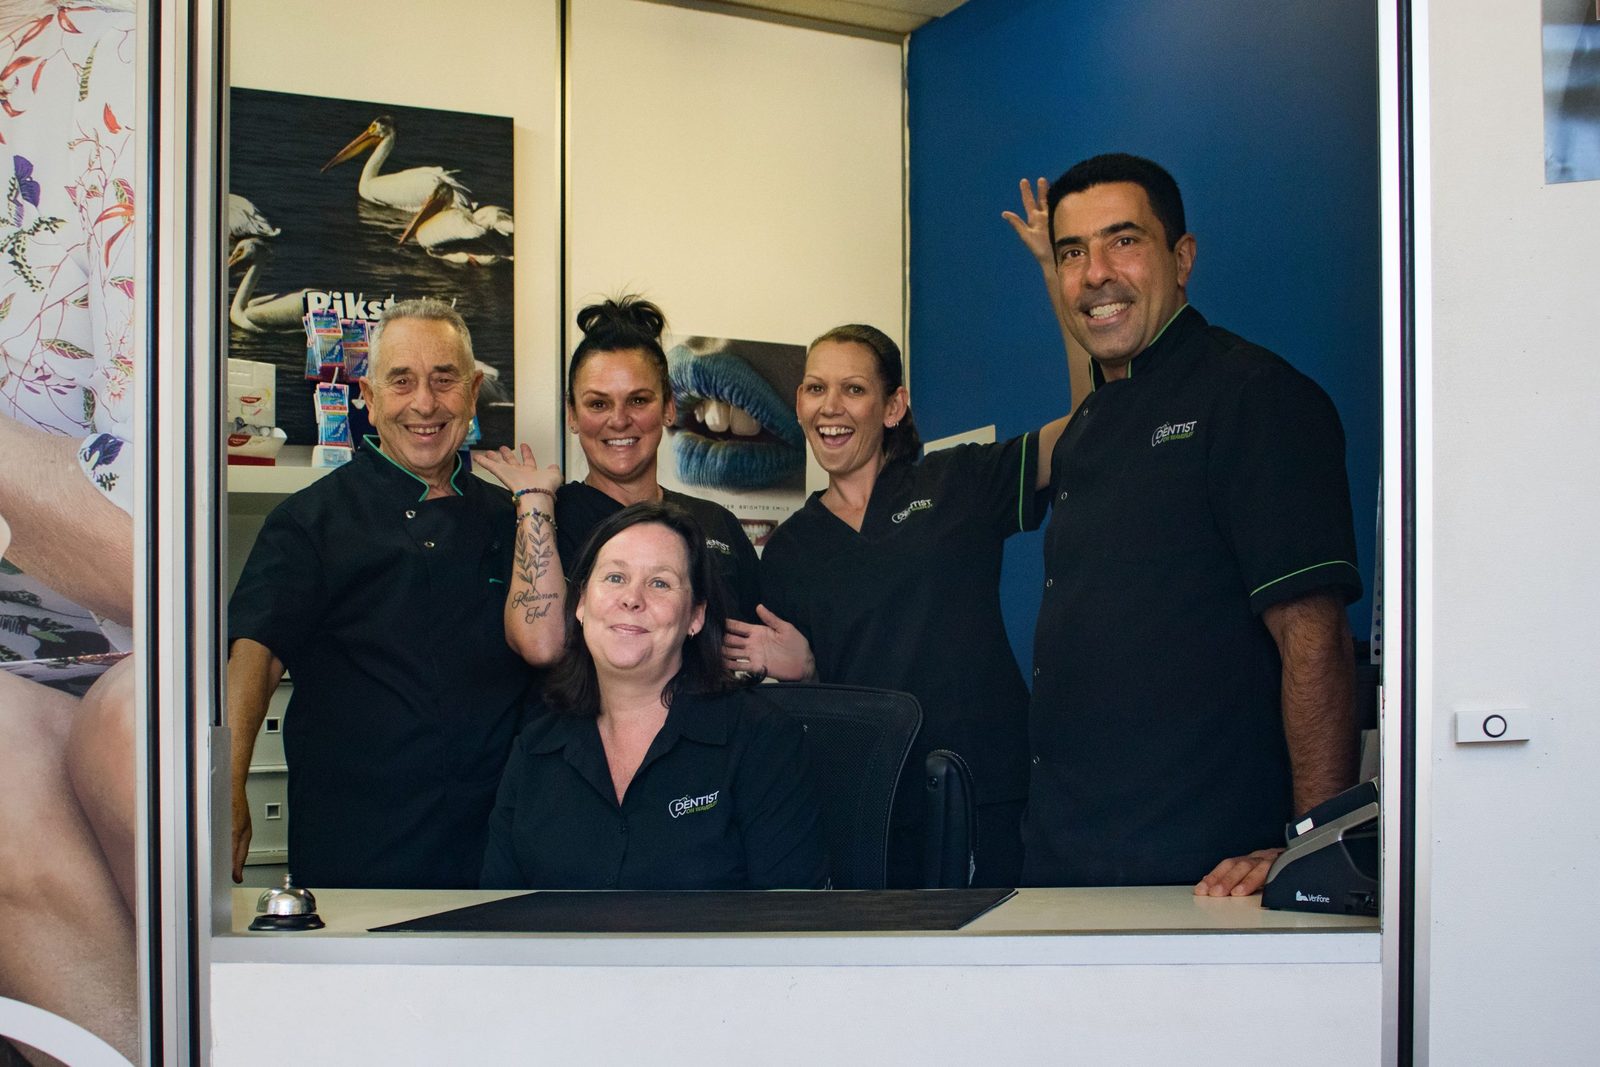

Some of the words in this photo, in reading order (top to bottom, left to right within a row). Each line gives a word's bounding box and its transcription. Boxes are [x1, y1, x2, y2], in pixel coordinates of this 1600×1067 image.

[1155, 420, 1197, 440] DENTIST
[675, 790, 720, 812] DENTIST
[1308, 894, 1330, 903] VeriFone
